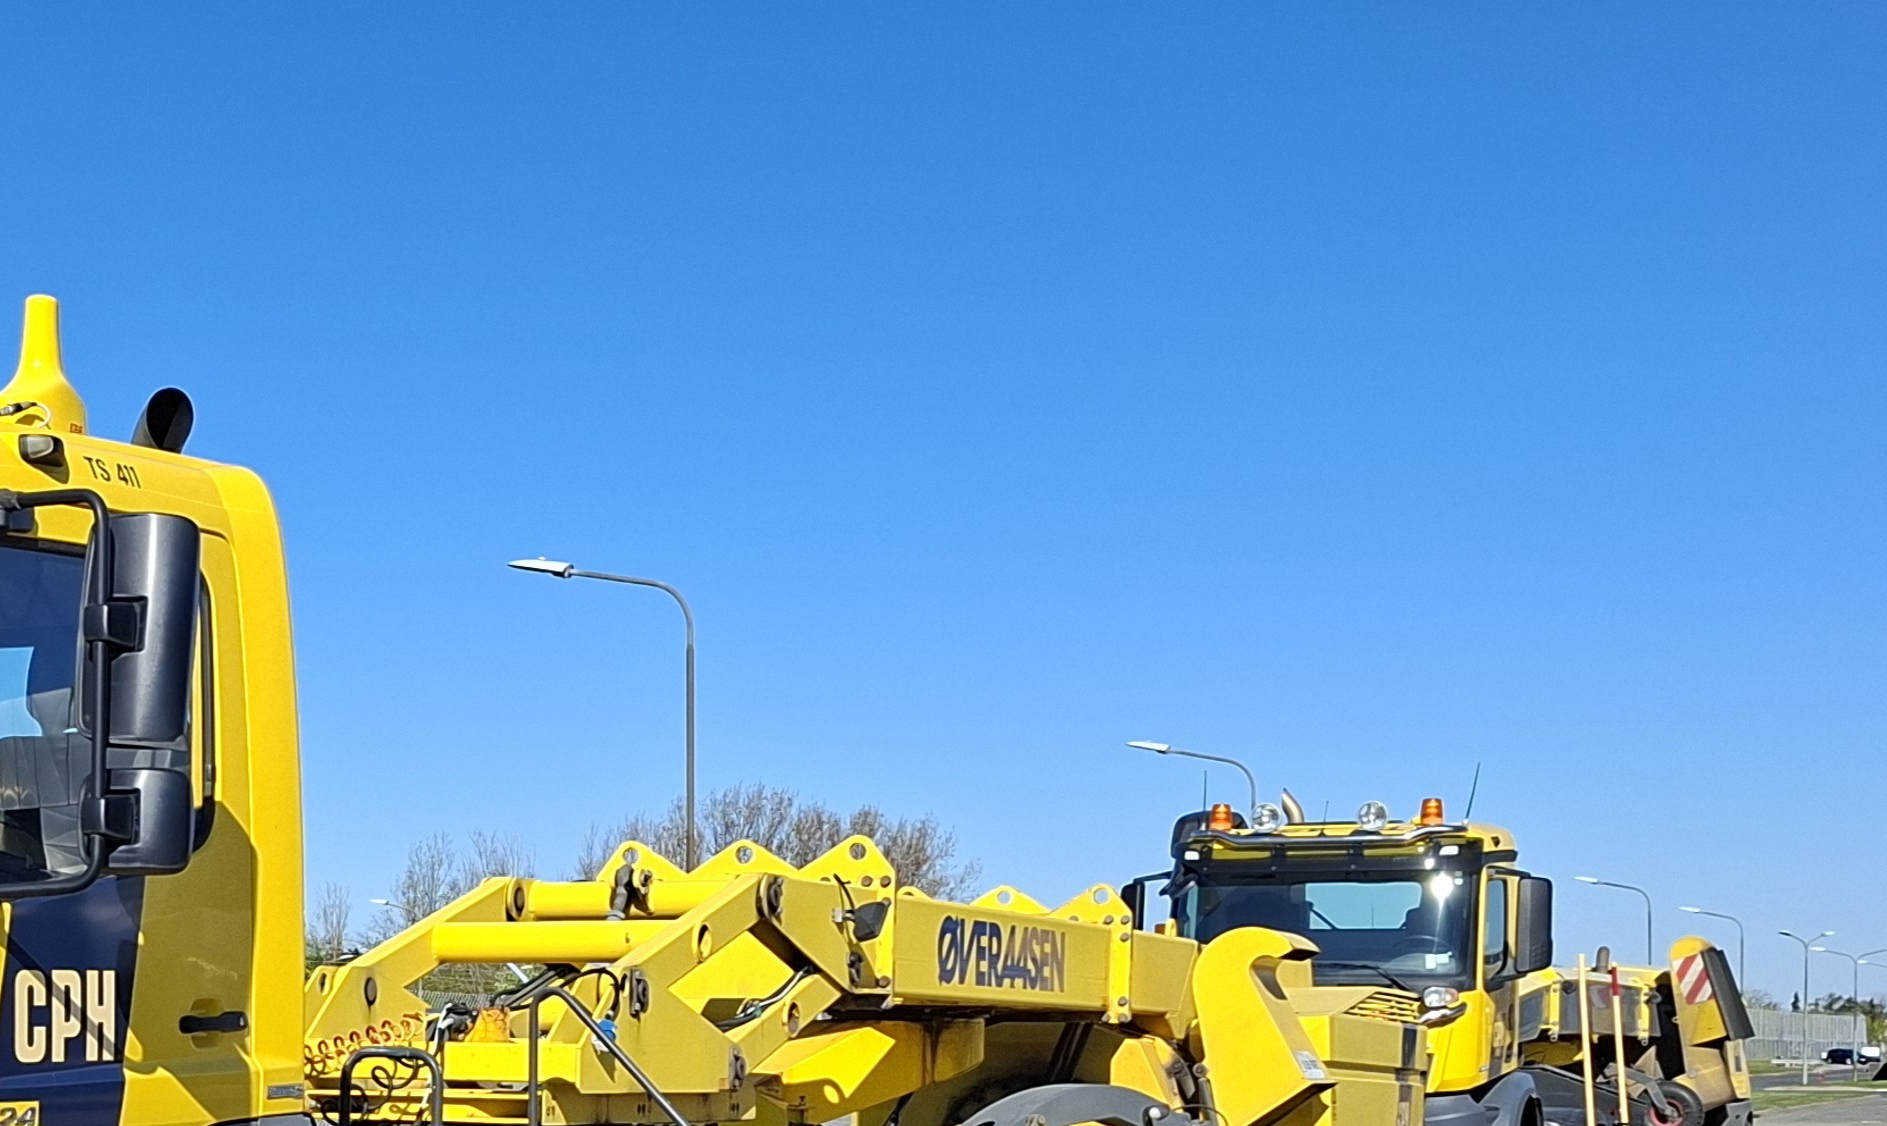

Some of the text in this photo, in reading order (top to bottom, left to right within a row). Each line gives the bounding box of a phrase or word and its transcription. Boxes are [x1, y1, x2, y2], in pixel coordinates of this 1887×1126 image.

[83, 455, 141, 489] TS 411
[937, 914, 1066, 994] ØVERAASEN
[14, 968, 116, 1064] CPH
